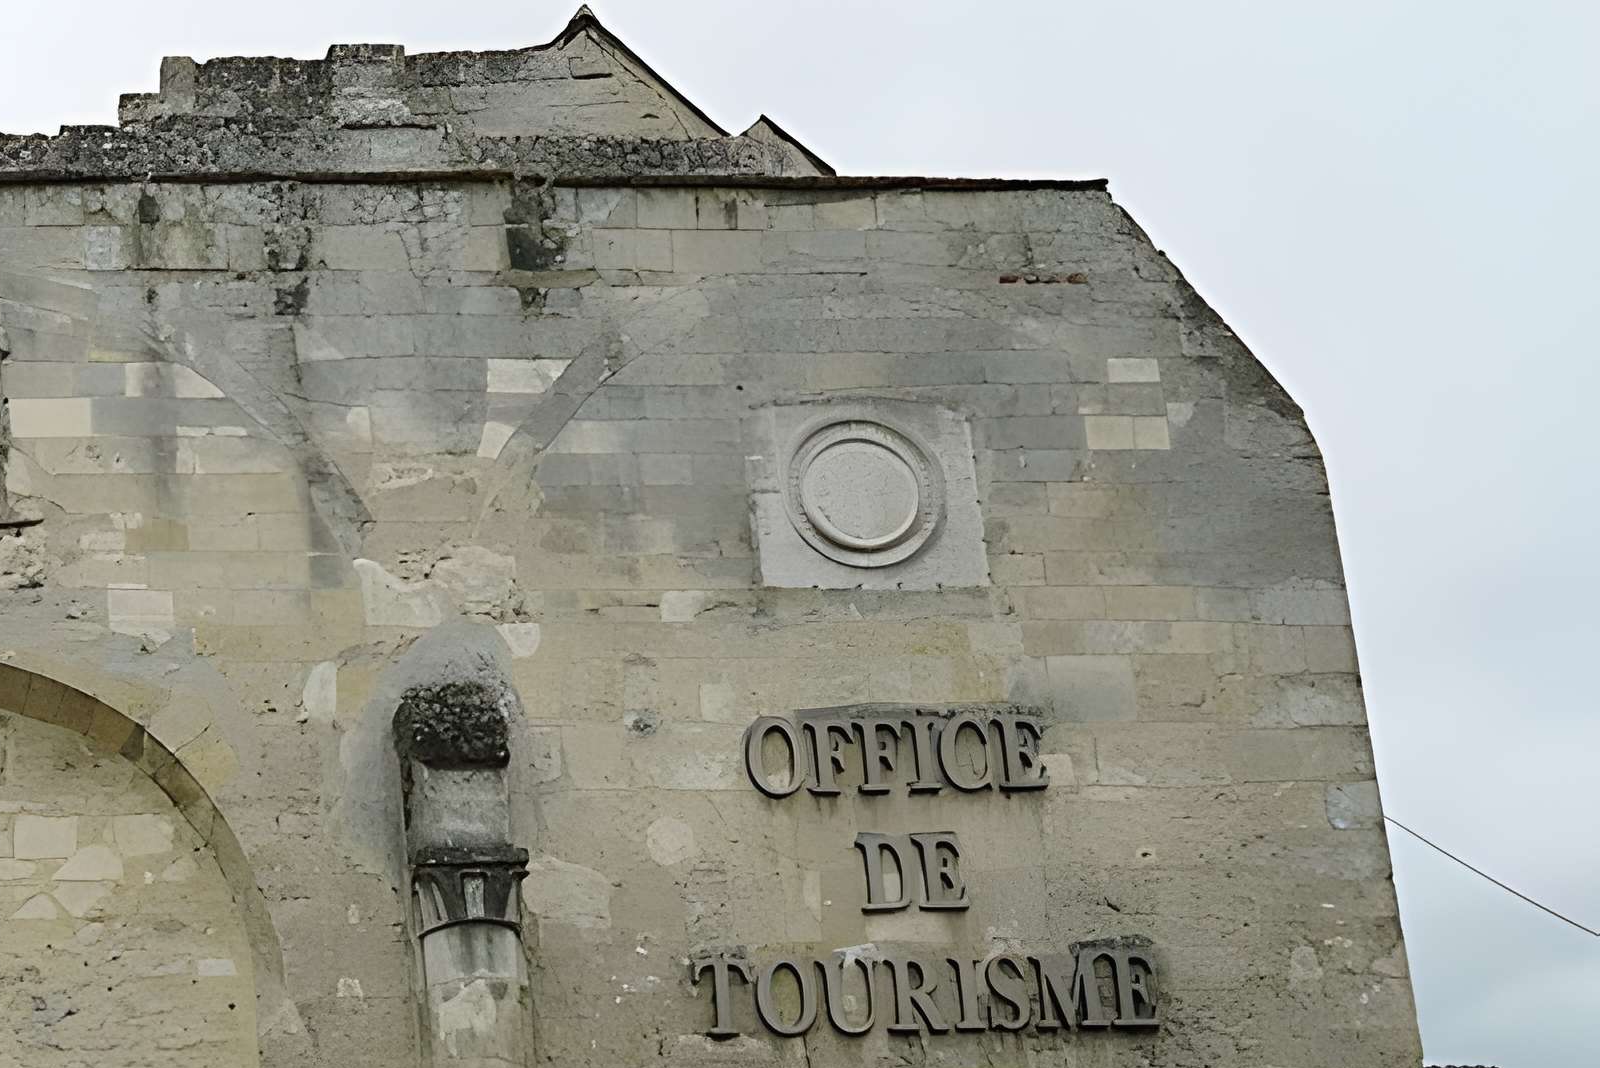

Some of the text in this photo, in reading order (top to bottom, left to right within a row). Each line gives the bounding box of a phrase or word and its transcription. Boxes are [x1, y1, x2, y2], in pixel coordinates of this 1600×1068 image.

[743, 712, 1050, 799] OFFICE
[854, 831, 970, 912] DE
[692, 946, 1161, 1039] TOURISME
